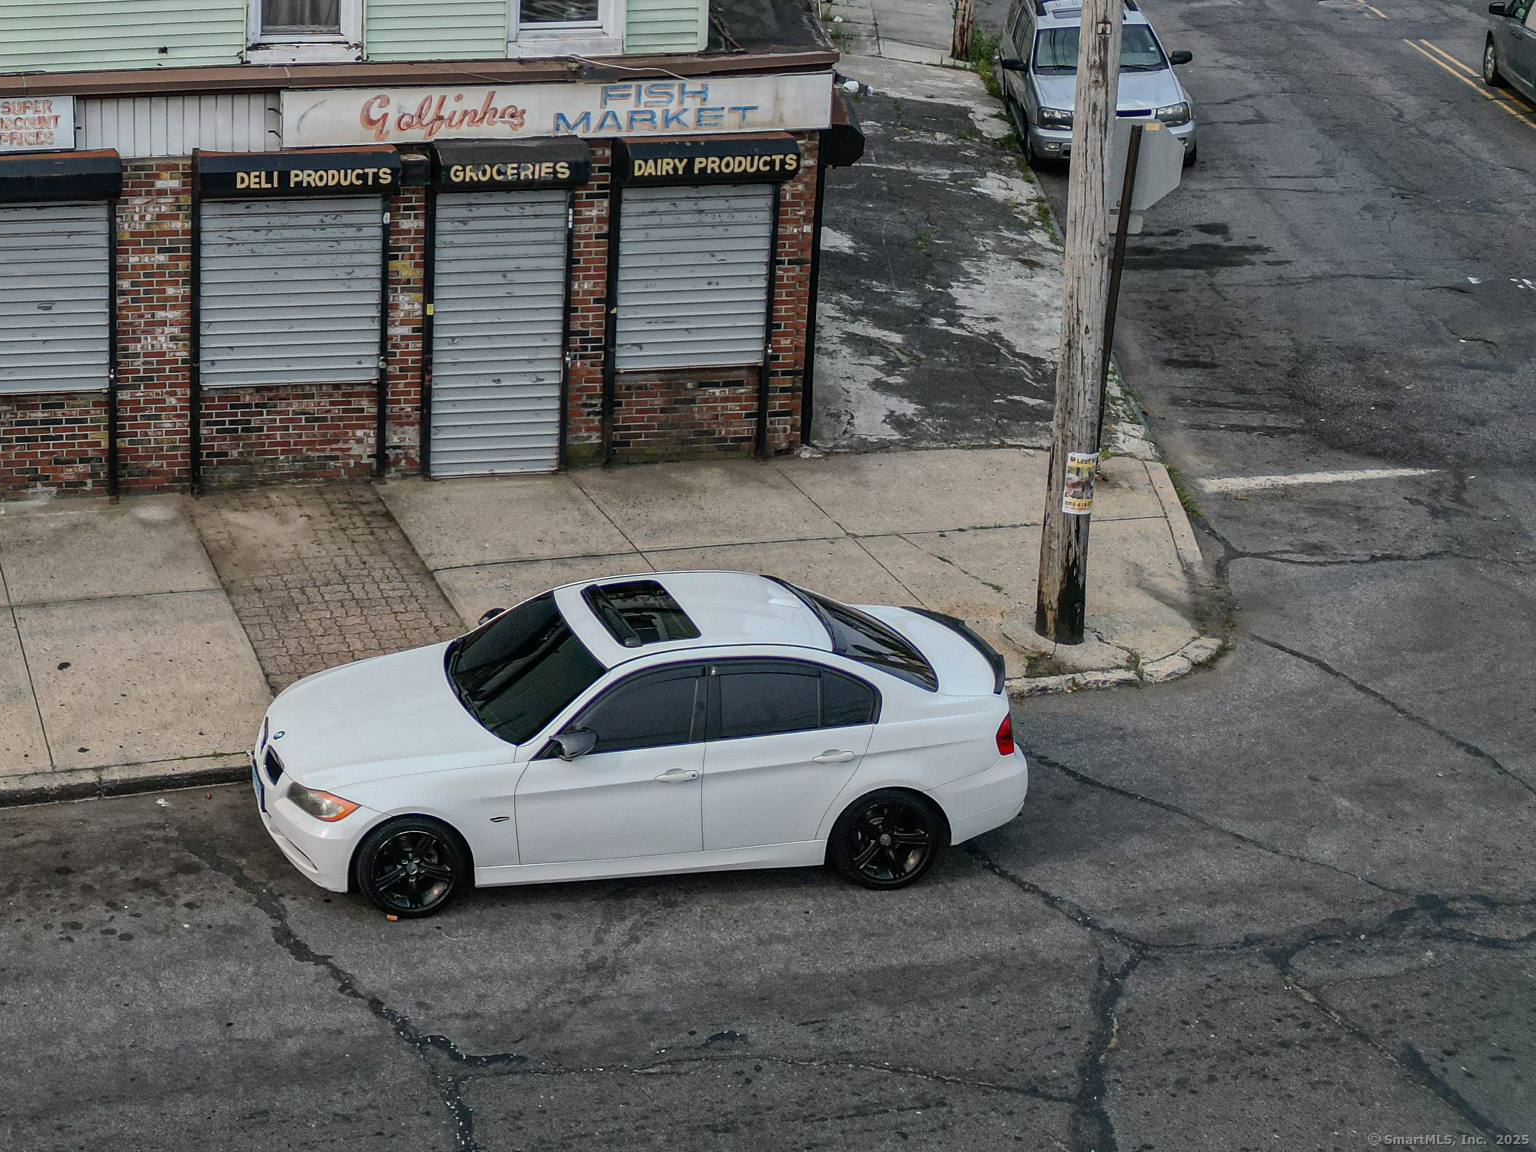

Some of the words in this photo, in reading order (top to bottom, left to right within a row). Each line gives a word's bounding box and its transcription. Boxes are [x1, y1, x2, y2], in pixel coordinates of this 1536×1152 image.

[600, 83, 709, 108] FISH
[0, 99, 53, 115] SUPER
[553, 105, 759, 135] MARKET
[450, 161, 570, 182] GROCERIES
[634, 158, 688, 176] DAIRY
[693, 154, 797, 174] PRODUCTS
[236, 171, 279, 189] DELI
[289, 167, 392, 188] PRODUCTS
